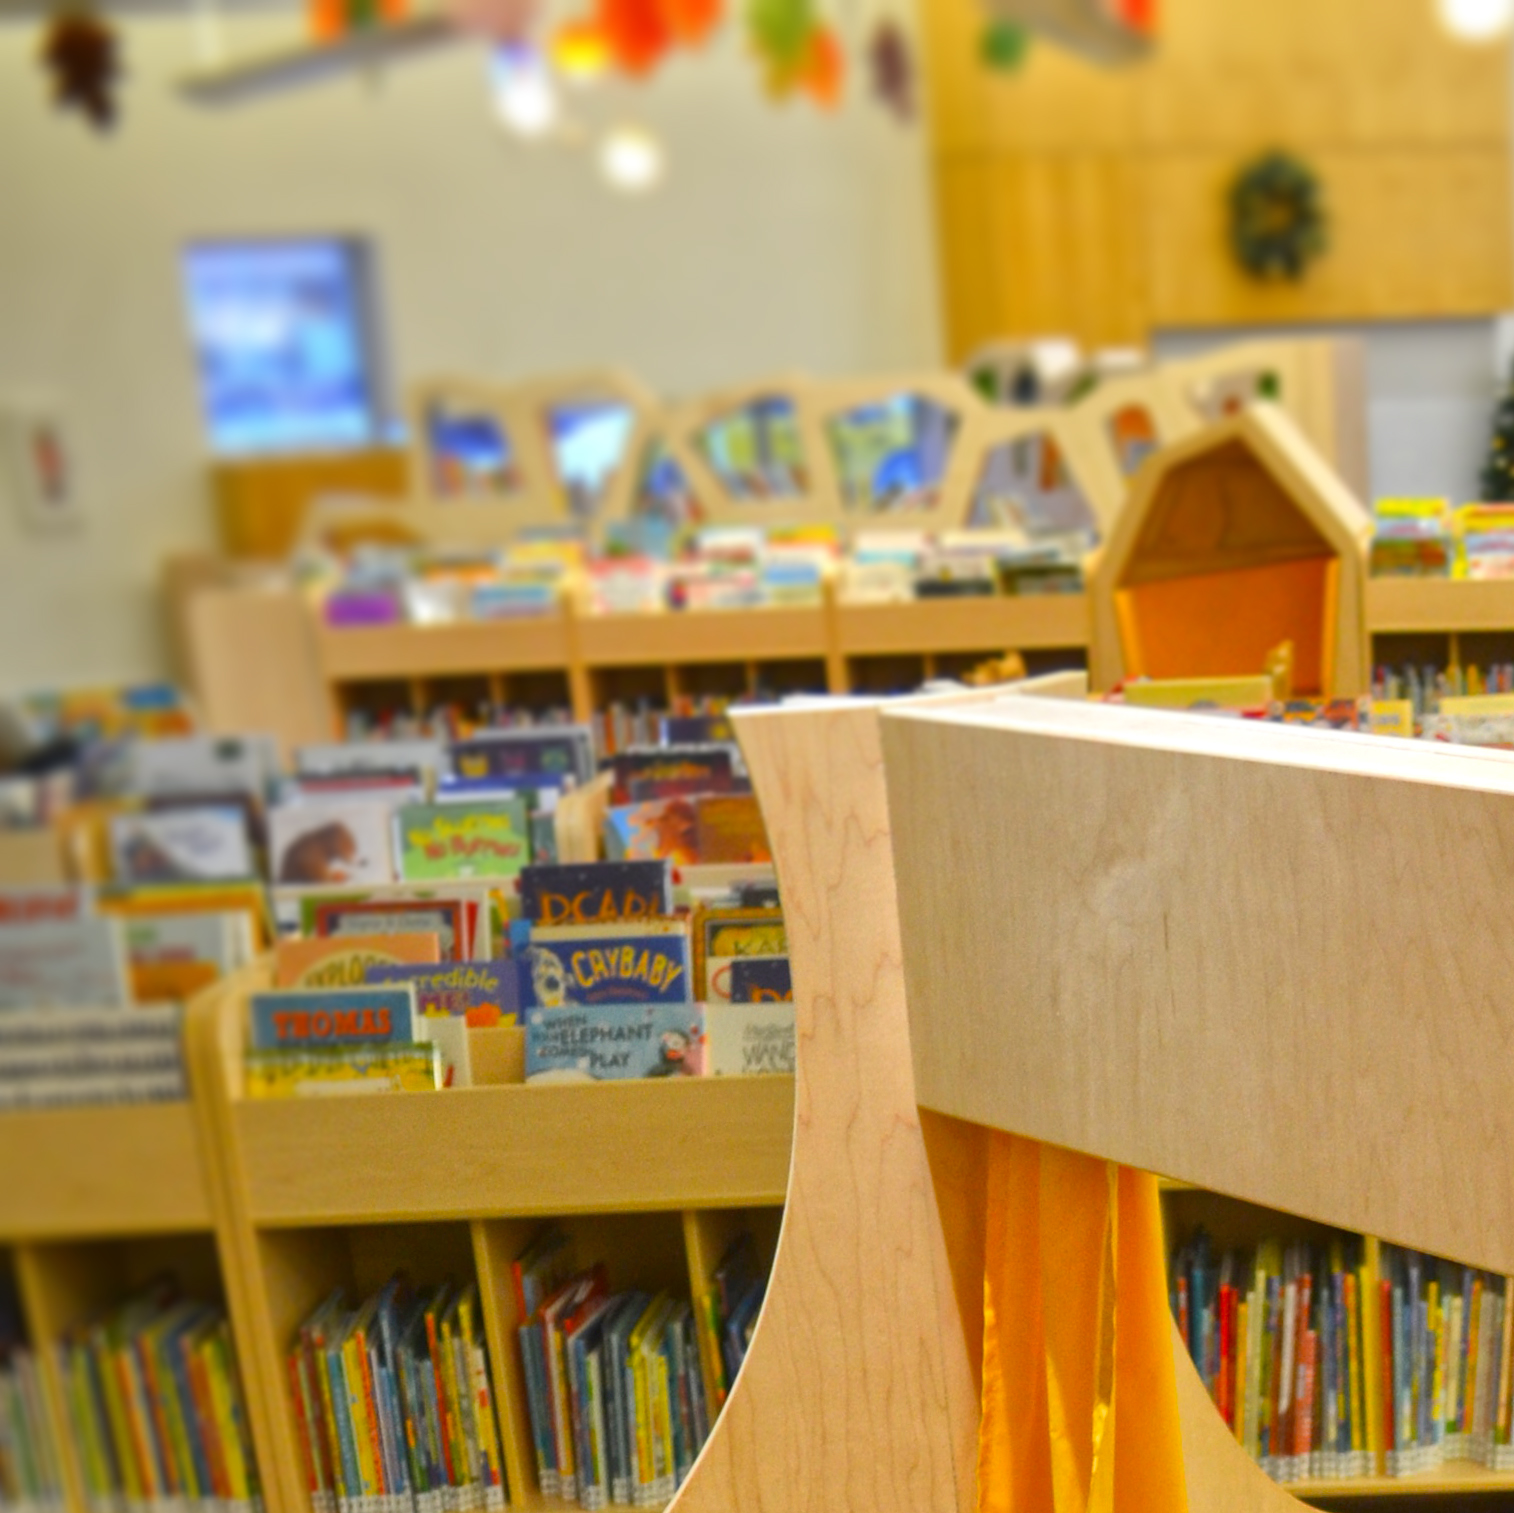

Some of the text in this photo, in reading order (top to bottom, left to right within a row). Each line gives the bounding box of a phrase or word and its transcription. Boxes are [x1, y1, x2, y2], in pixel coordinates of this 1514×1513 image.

[571, 945, 682, 993] CRYBABY
[272, 1007, 391, 1039] THOMAS
[560, 1023, 653, 1045] ELEPHANT
[589, 1052, 630, 1068] PLAY
